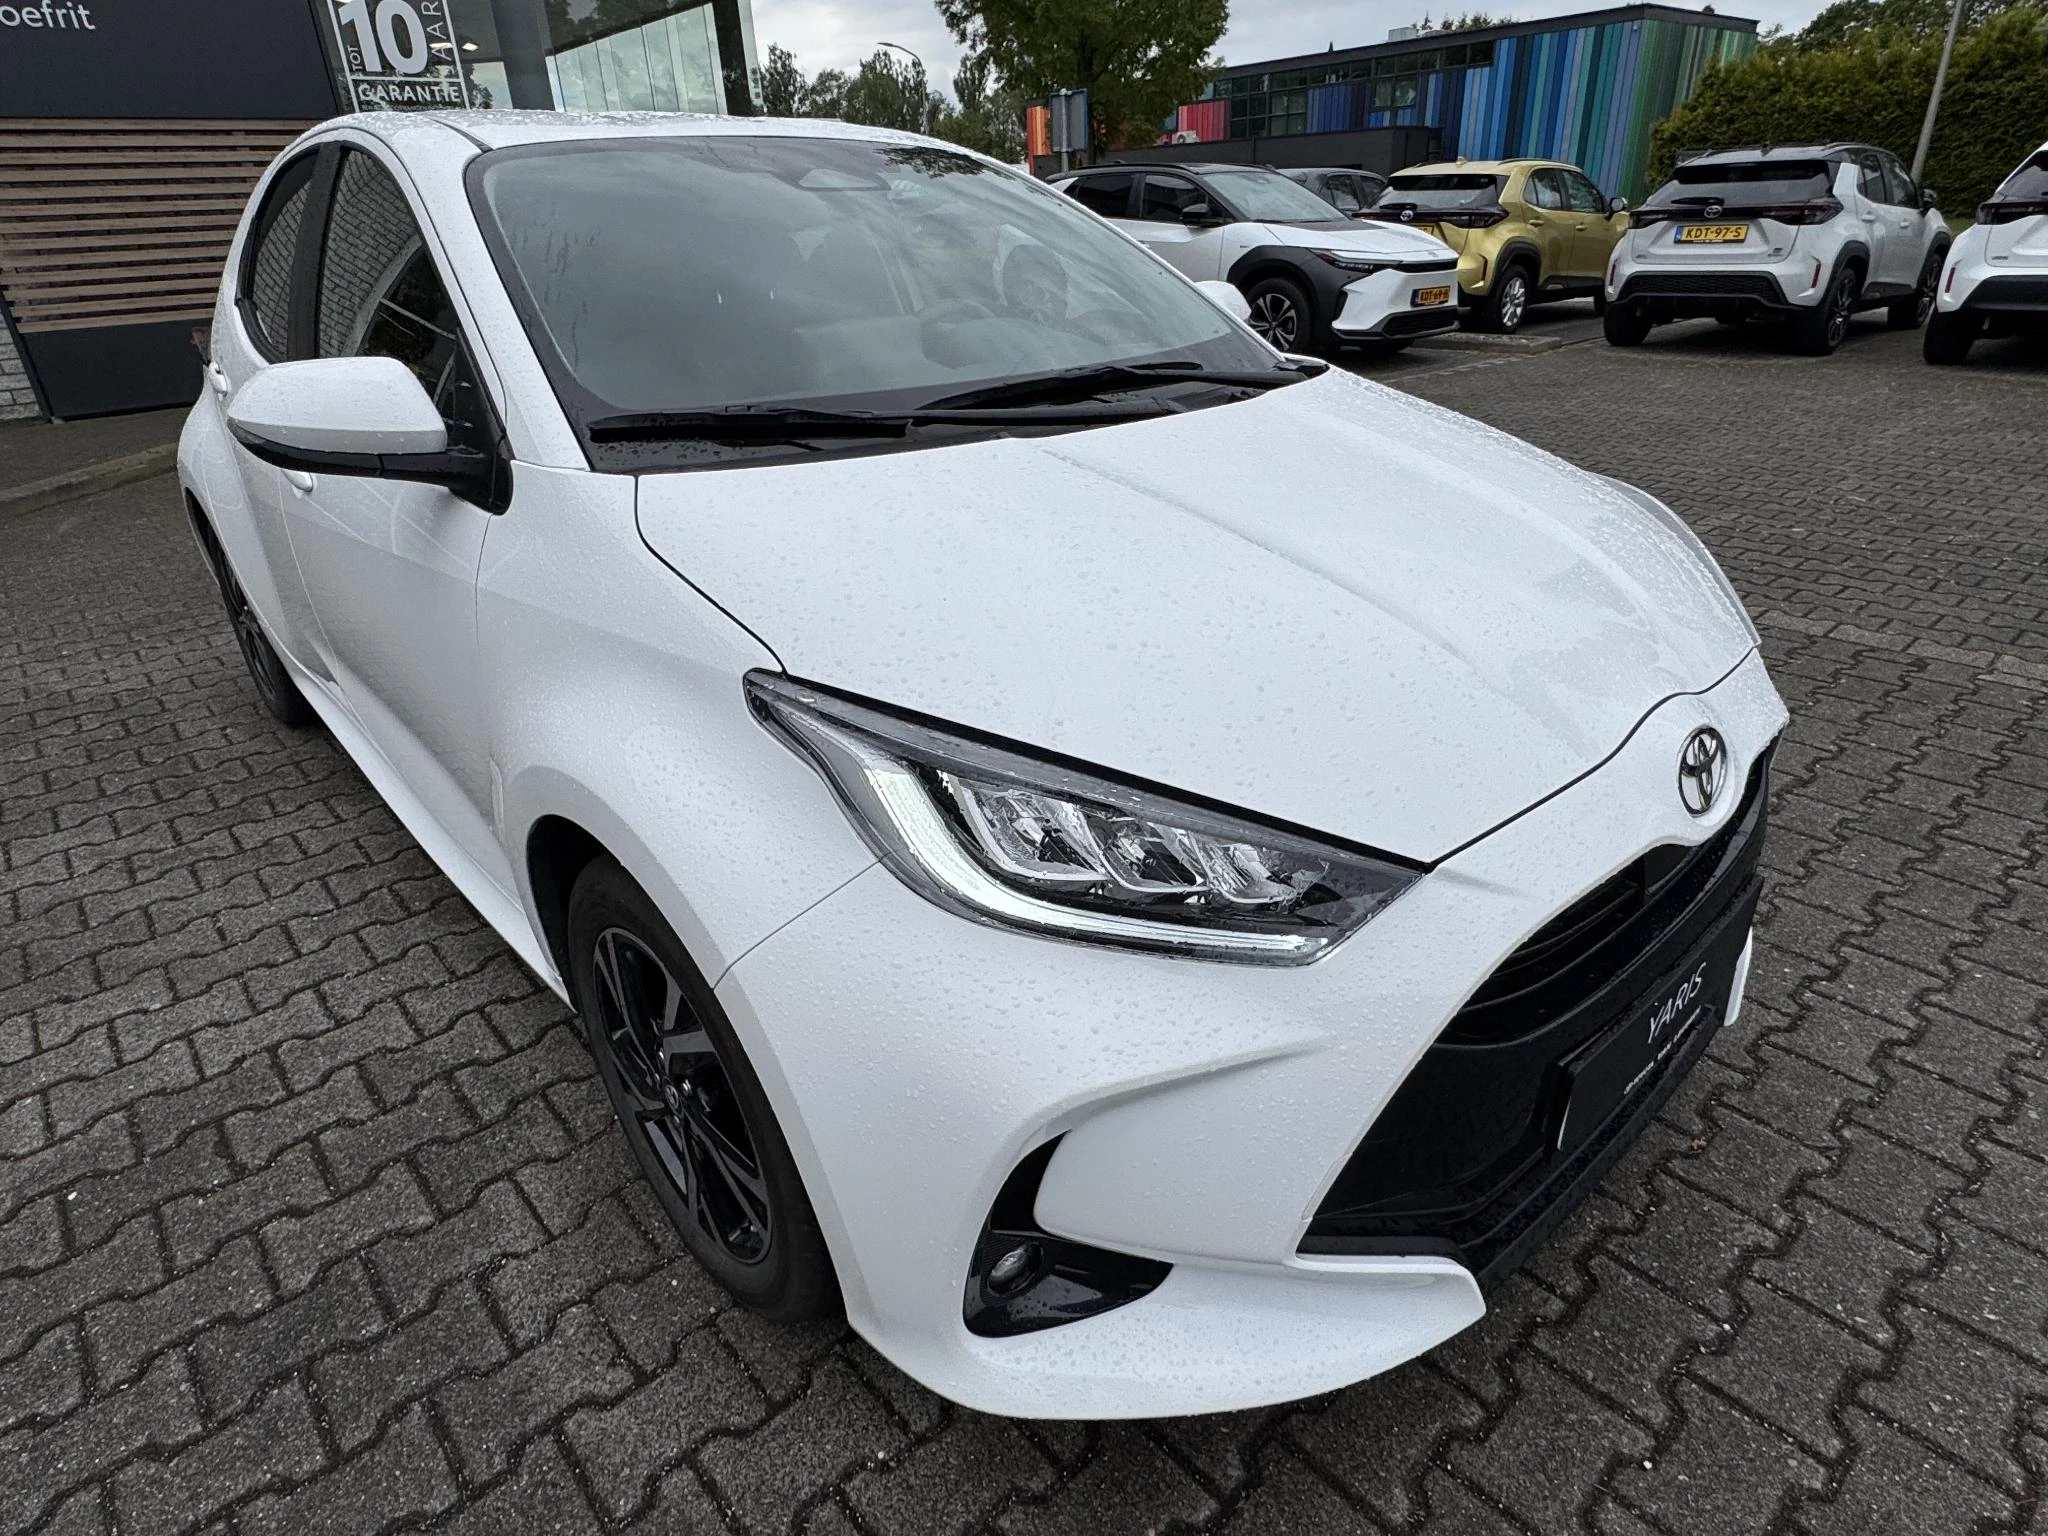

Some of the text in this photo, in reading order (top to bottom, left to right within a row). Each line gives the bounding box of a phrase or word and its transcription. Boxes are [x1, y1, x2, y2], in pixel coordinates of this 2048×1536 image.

[338, 0, 428, 74] 10
[347, 45, 363, 71] TOT
[358, 84, 460, 101] GARANTIE
[1685, 227, 1742, 239] KDT-97-S
[1648, 962, 1706, 1044] YARIS
